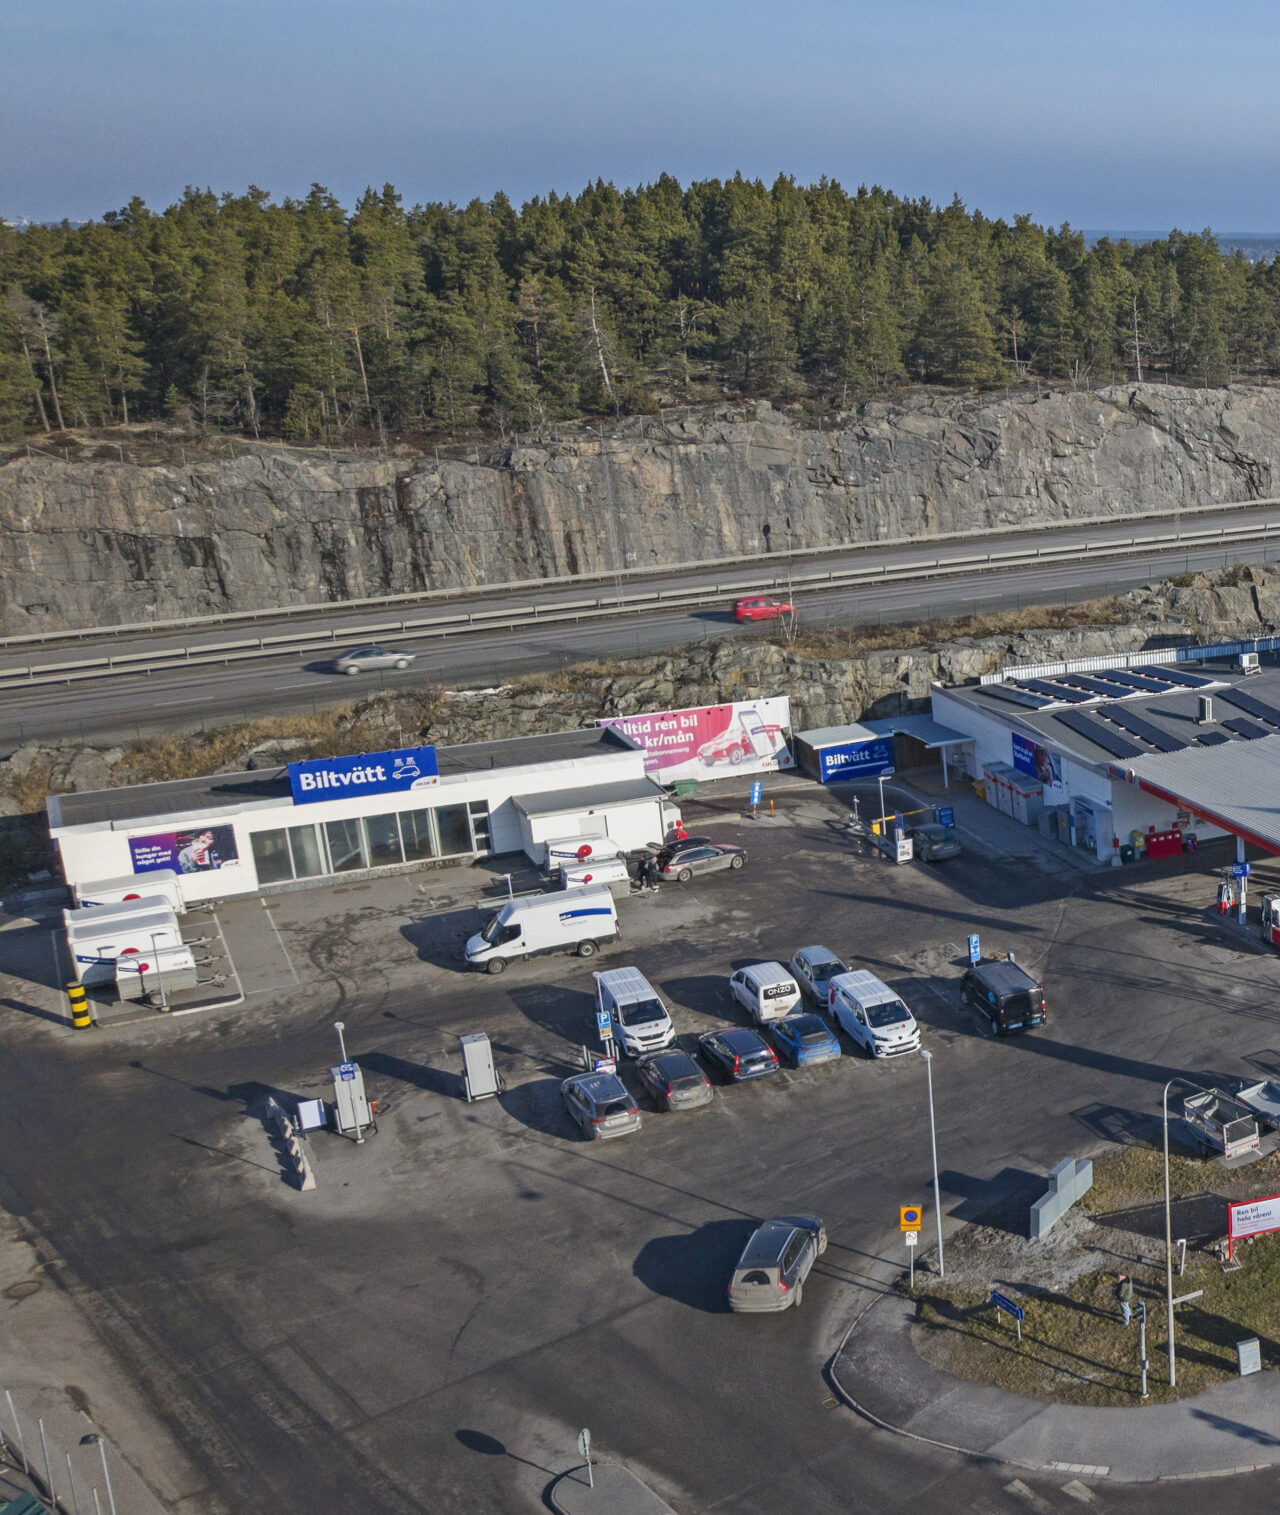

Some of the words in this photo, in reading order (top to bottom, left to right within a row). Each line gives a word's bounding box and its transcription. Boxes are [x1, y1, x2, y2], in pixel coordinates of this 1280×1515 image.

[654, 719, 678, 732] ren
[680, 714, 698, 728] bil
[645, 731, 694, 748] kr/mån
[826, 751, 871, 767] Biltvätt
[299, 765, 387, 791] Biltvätt
[767, 985, 791, 996] ONZO
